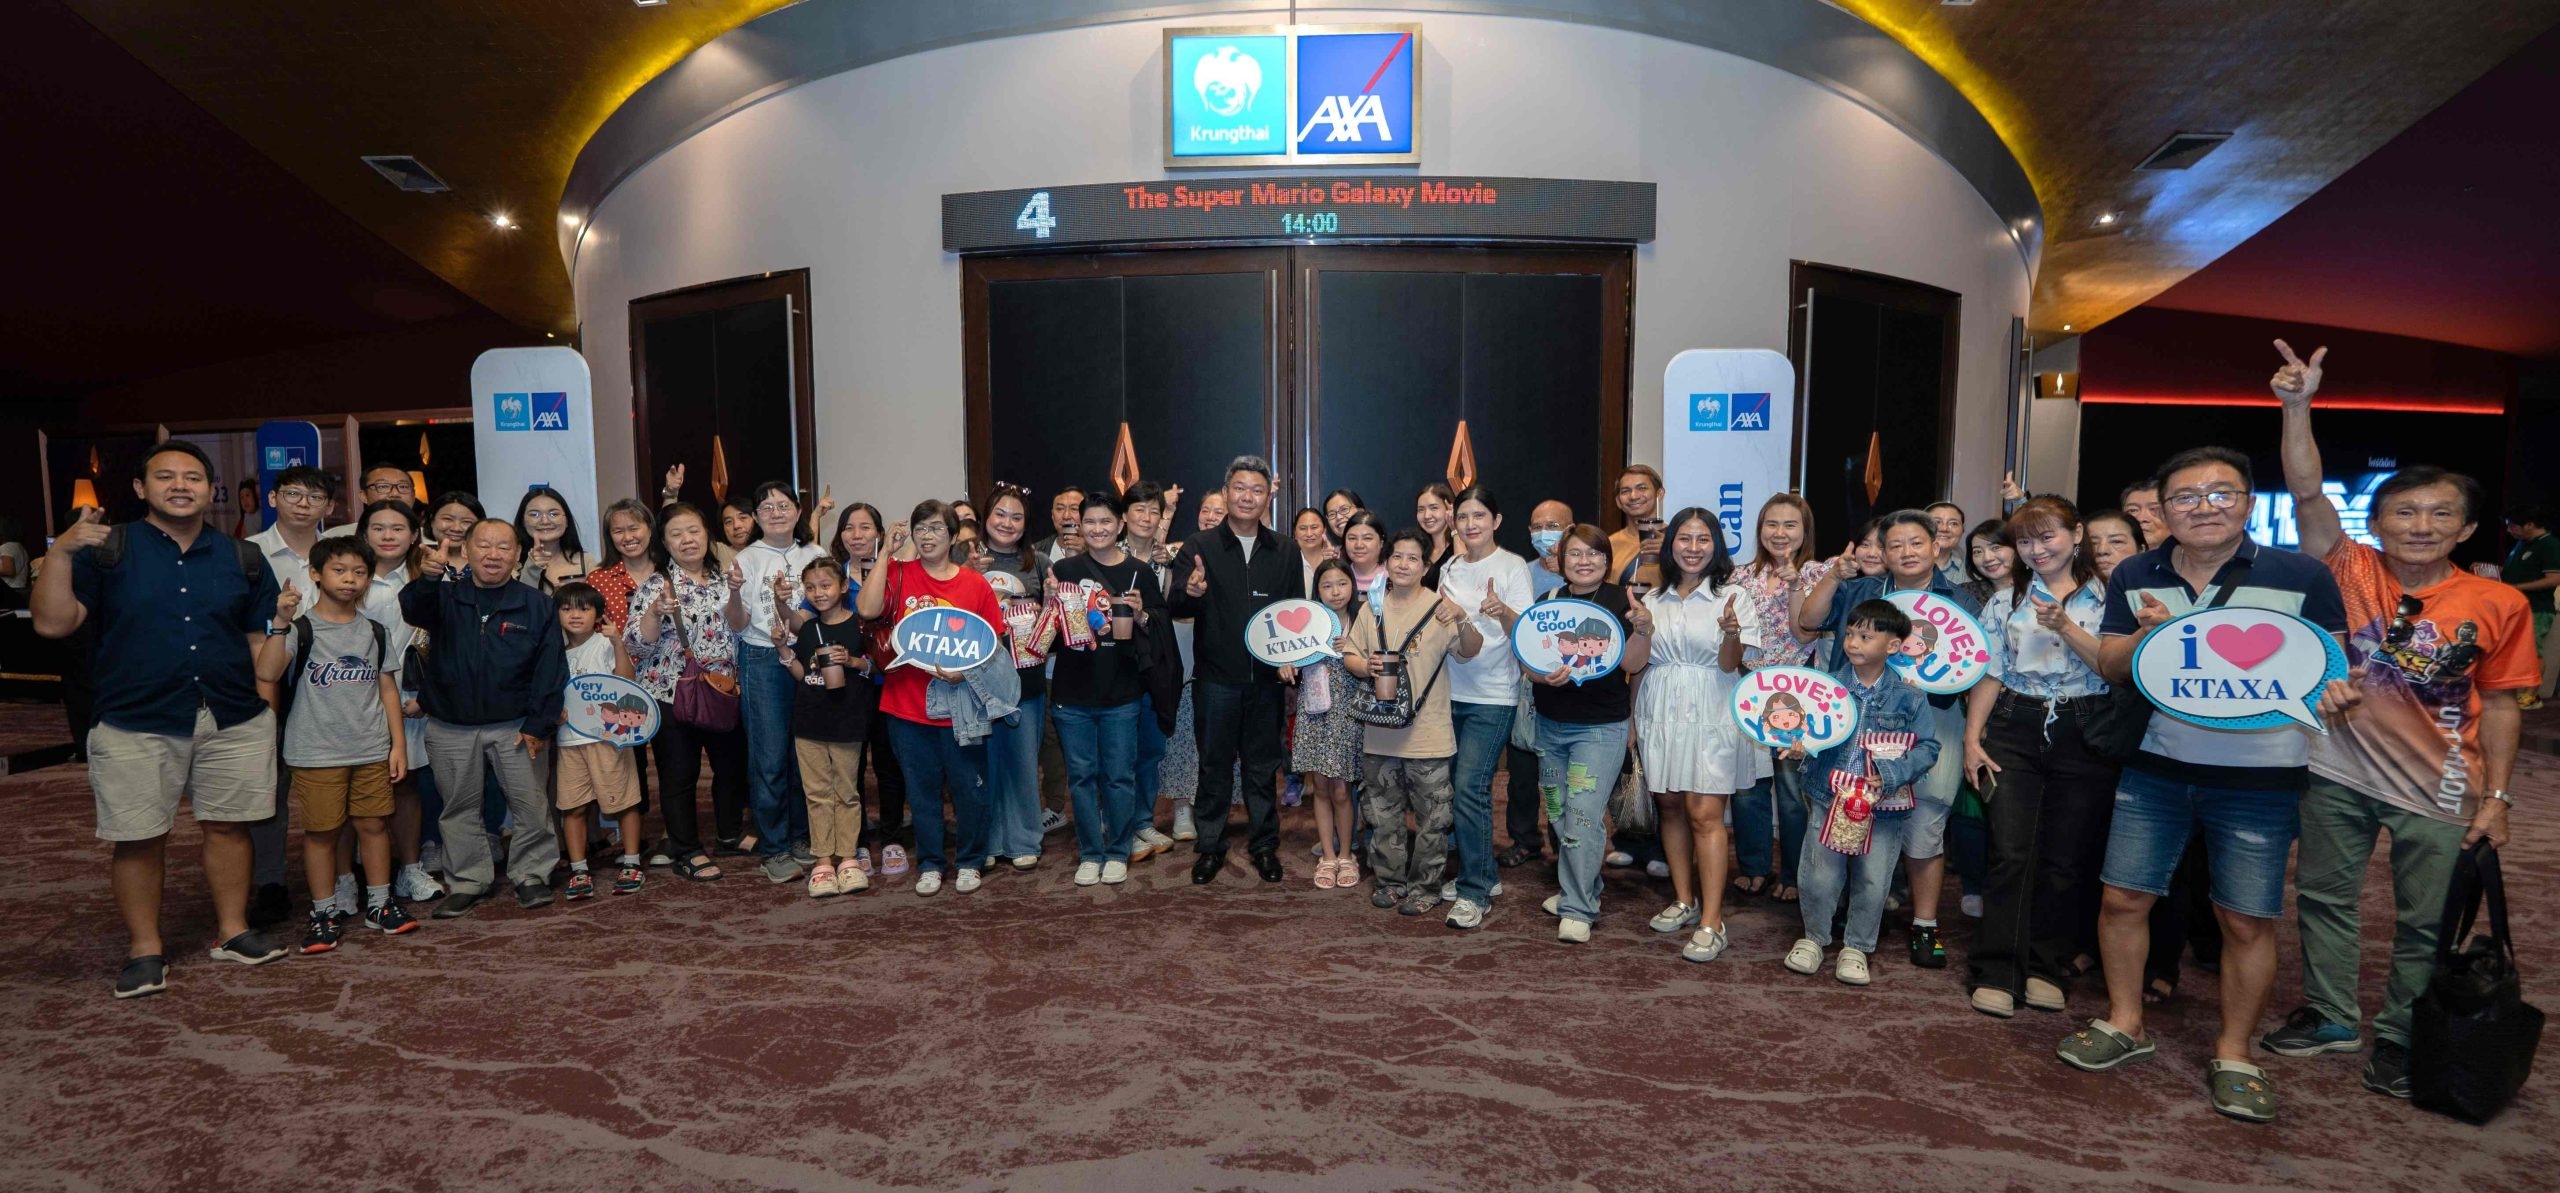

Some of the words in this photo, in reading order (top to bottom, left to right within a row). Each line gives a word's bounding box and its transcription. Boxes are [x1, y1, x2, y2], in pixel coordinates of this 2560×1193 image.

[1297, 95, 1393, 142] AXA
[1190, 125, 1270, 145] Krungthai
[1124, 185, 1169, 209] The
[1174, 185, 1244, 212] Super
[1251, 182, 1326, 204] Mario
[1331, 181, 1415, 208] Galaxy
[1421, 181, 1497, 204] Movie
[1016, 191, 1056, 238] 4
[1282, 213, 1338, 233] 14:00
[533, 412, 562, 427] AXA
[1731, 412, 1763, 428] AXA
[933, 612, 942, 631] I
[1264, 612, 1279, 639] i
[1527, 609, 1560, 622] Very
[1537, 617, 1576, 633] Good
[1913, 594, 1975, 652] LOVE
[908, 631, 979, 660] KTAXA
[1265, 635, 1320, 656] KTAXA
[2179, 624, 2202, 669] i
[571, 681, 603, 692] Very
[581, 691, 618, 701] Good
[1756, 671, 1827, 703] LOVE
[2170, 678, 2289, 700] KTAXA
[1744, 713, 1832, 741] YU
